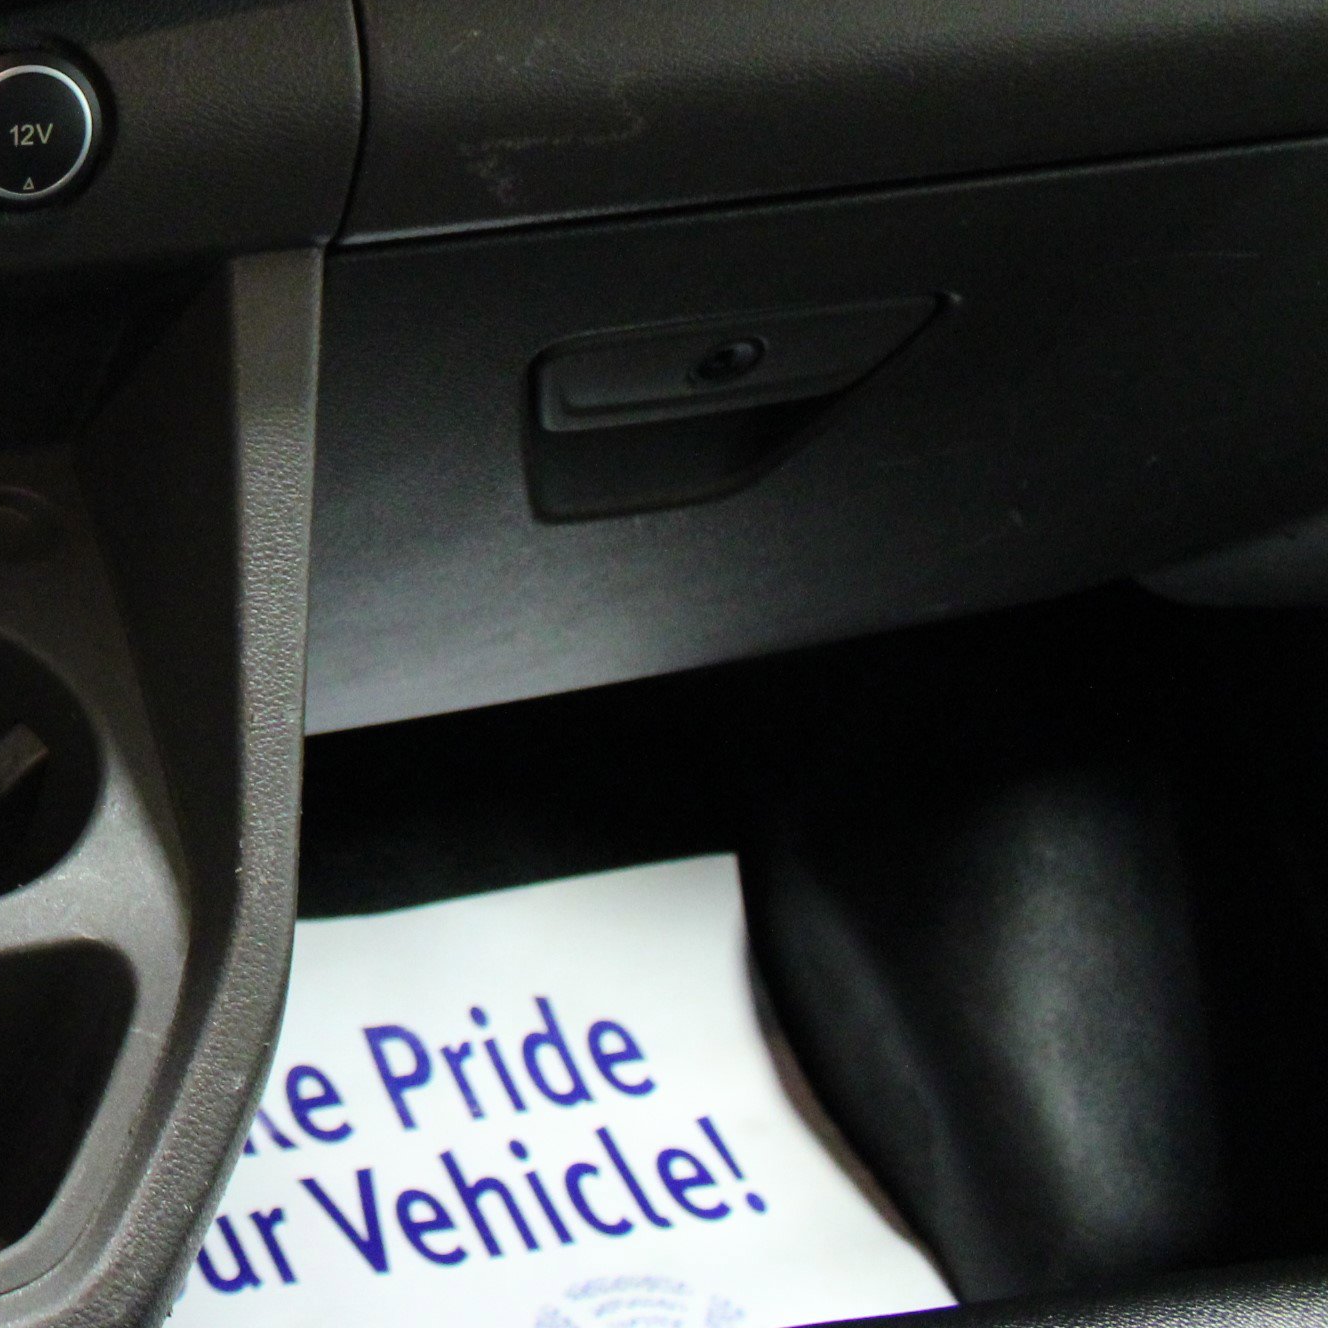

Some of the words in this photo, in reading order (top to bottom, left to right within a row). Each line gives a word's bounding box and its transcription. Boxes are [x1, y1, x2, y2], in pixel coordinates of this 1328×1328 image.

[9, 122, 54, 148] 12V
[362, 995, 659, 1131] Pride
[298, 1115, 770, 1275] Vehicle!
